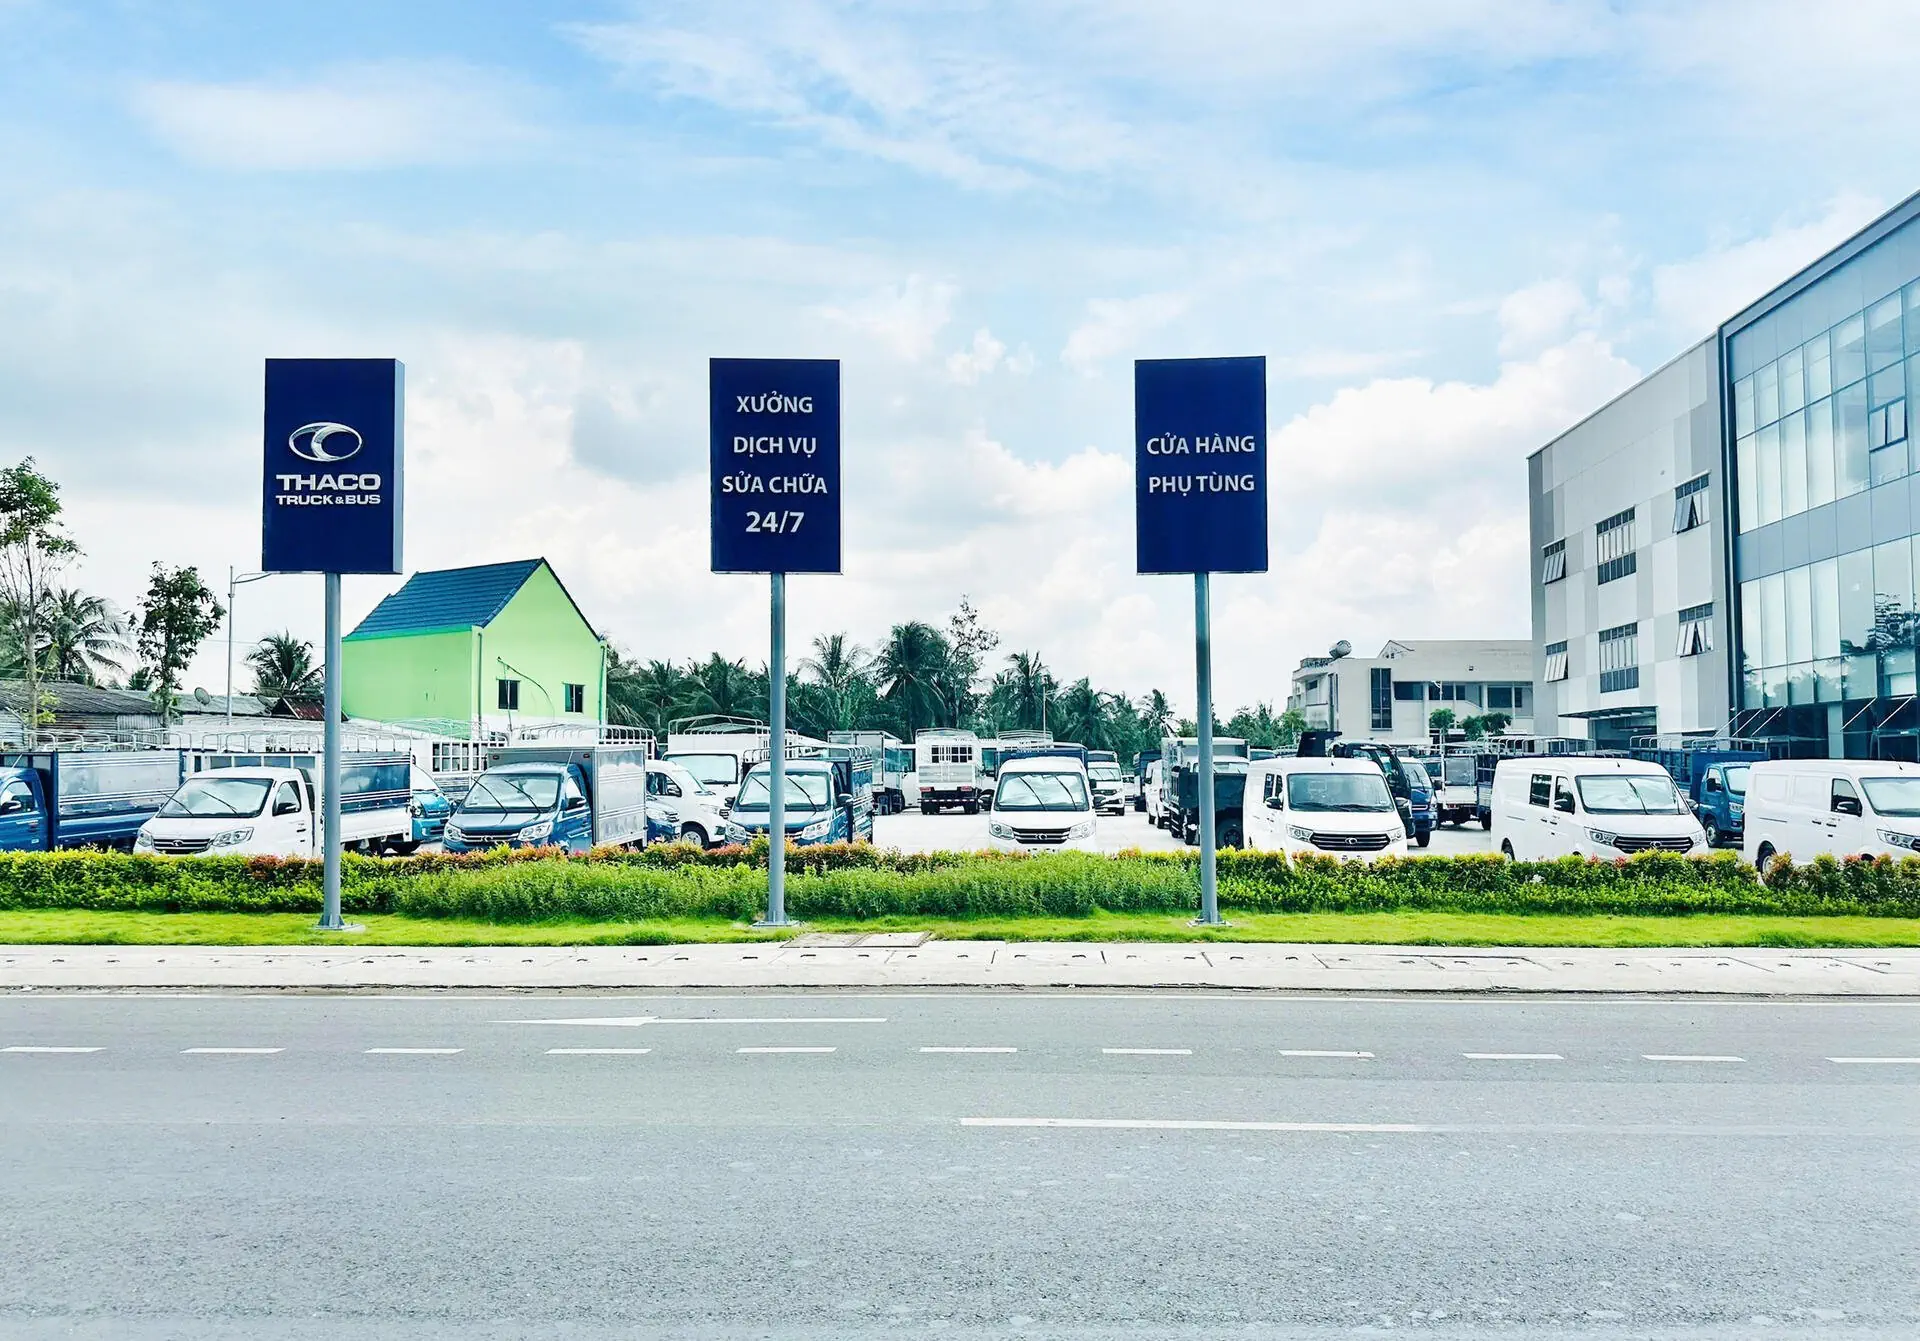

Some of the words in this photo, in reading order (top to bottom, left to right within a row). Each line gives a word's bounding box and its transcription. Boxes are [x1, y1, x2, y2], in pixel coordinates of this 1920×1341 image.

[736, 390, 813, 414] XƯỞNG
[733, 436, 783, 458] DỊCH
[788, 437, 817, 459] VỤ
[1146, 431, 1190, 455] CỬA
[1195, 431, 1256, 454] HÀNG
[275, 473, 382, 491] THACO
[721, 470, 765, 494] SỬA
[768, 472, 828, 494] CHỮA
[1148, 475, 1192, 497] PHỤ
[1195, 471, 1255, 493] TÙNG
[745, 510, 805, 534] 24/7
